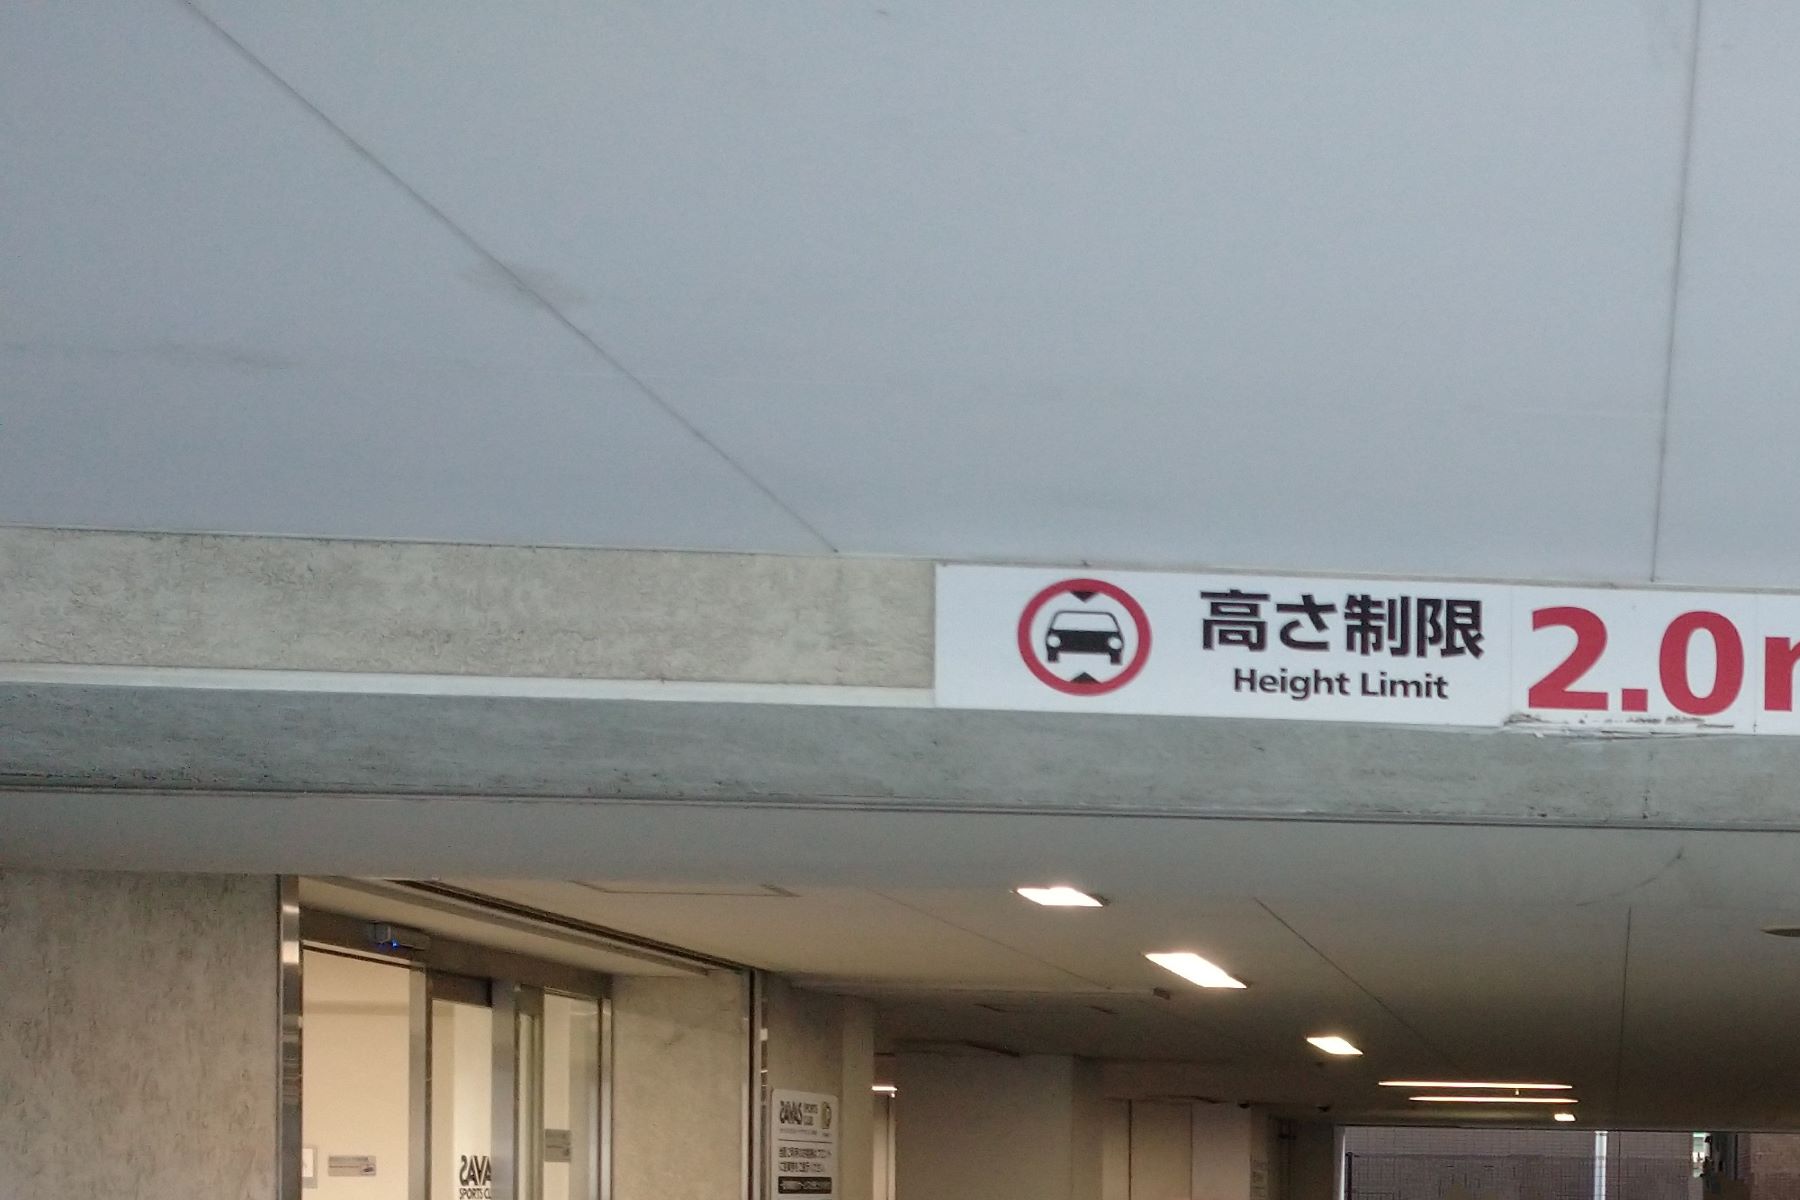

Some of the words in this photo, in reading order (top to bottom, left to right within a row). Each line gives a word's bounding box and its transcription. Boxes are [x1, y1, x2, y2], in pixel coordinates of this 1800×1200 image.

[1200, 588, 1487, 660] 高さ制限
[1234, 668, 1350, 702] Height
[1361, 671, 1449, 700] Limit
